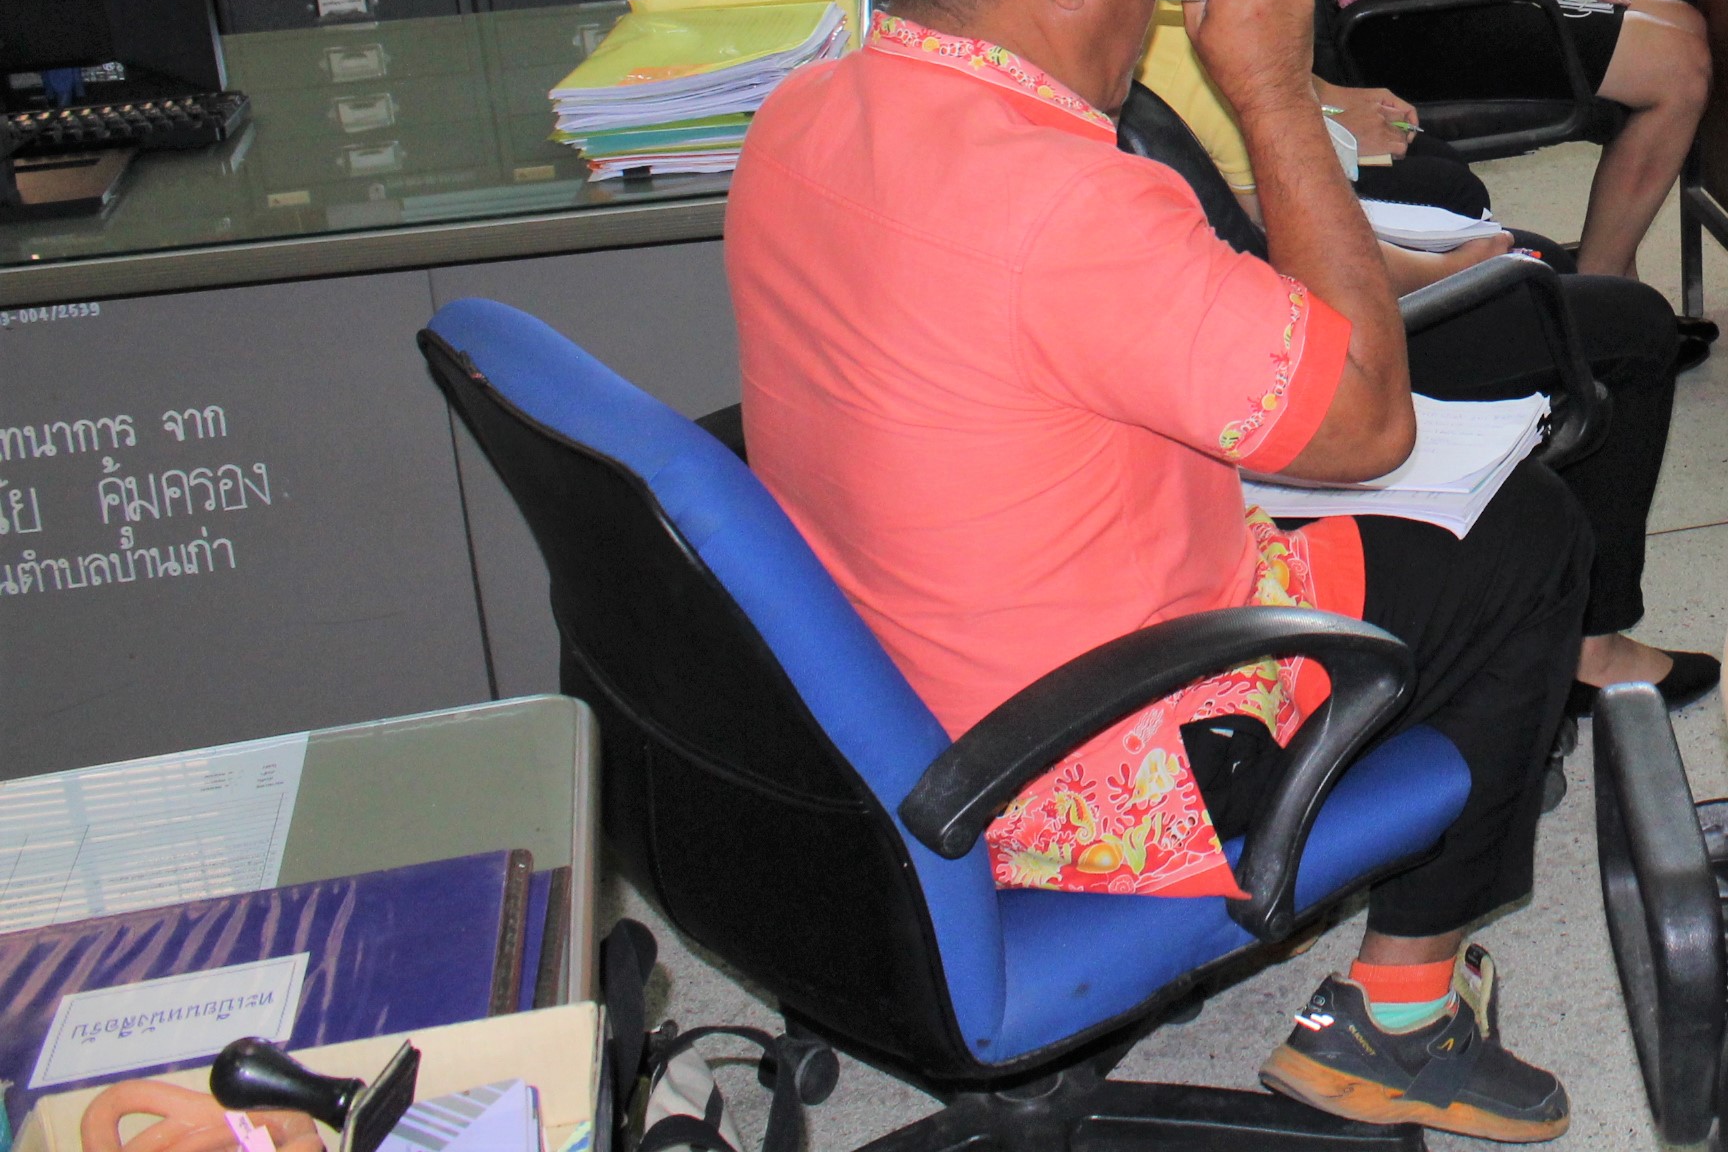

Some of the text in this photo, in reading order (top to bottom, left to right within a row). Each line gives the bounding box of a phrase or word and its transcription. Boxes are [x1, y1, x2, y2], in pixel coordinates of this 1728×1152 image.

[0, 405, 227, 461] ทนาการ จาก
[71, 990, 275, 1045] ทะเบียนหนังสือรับ
